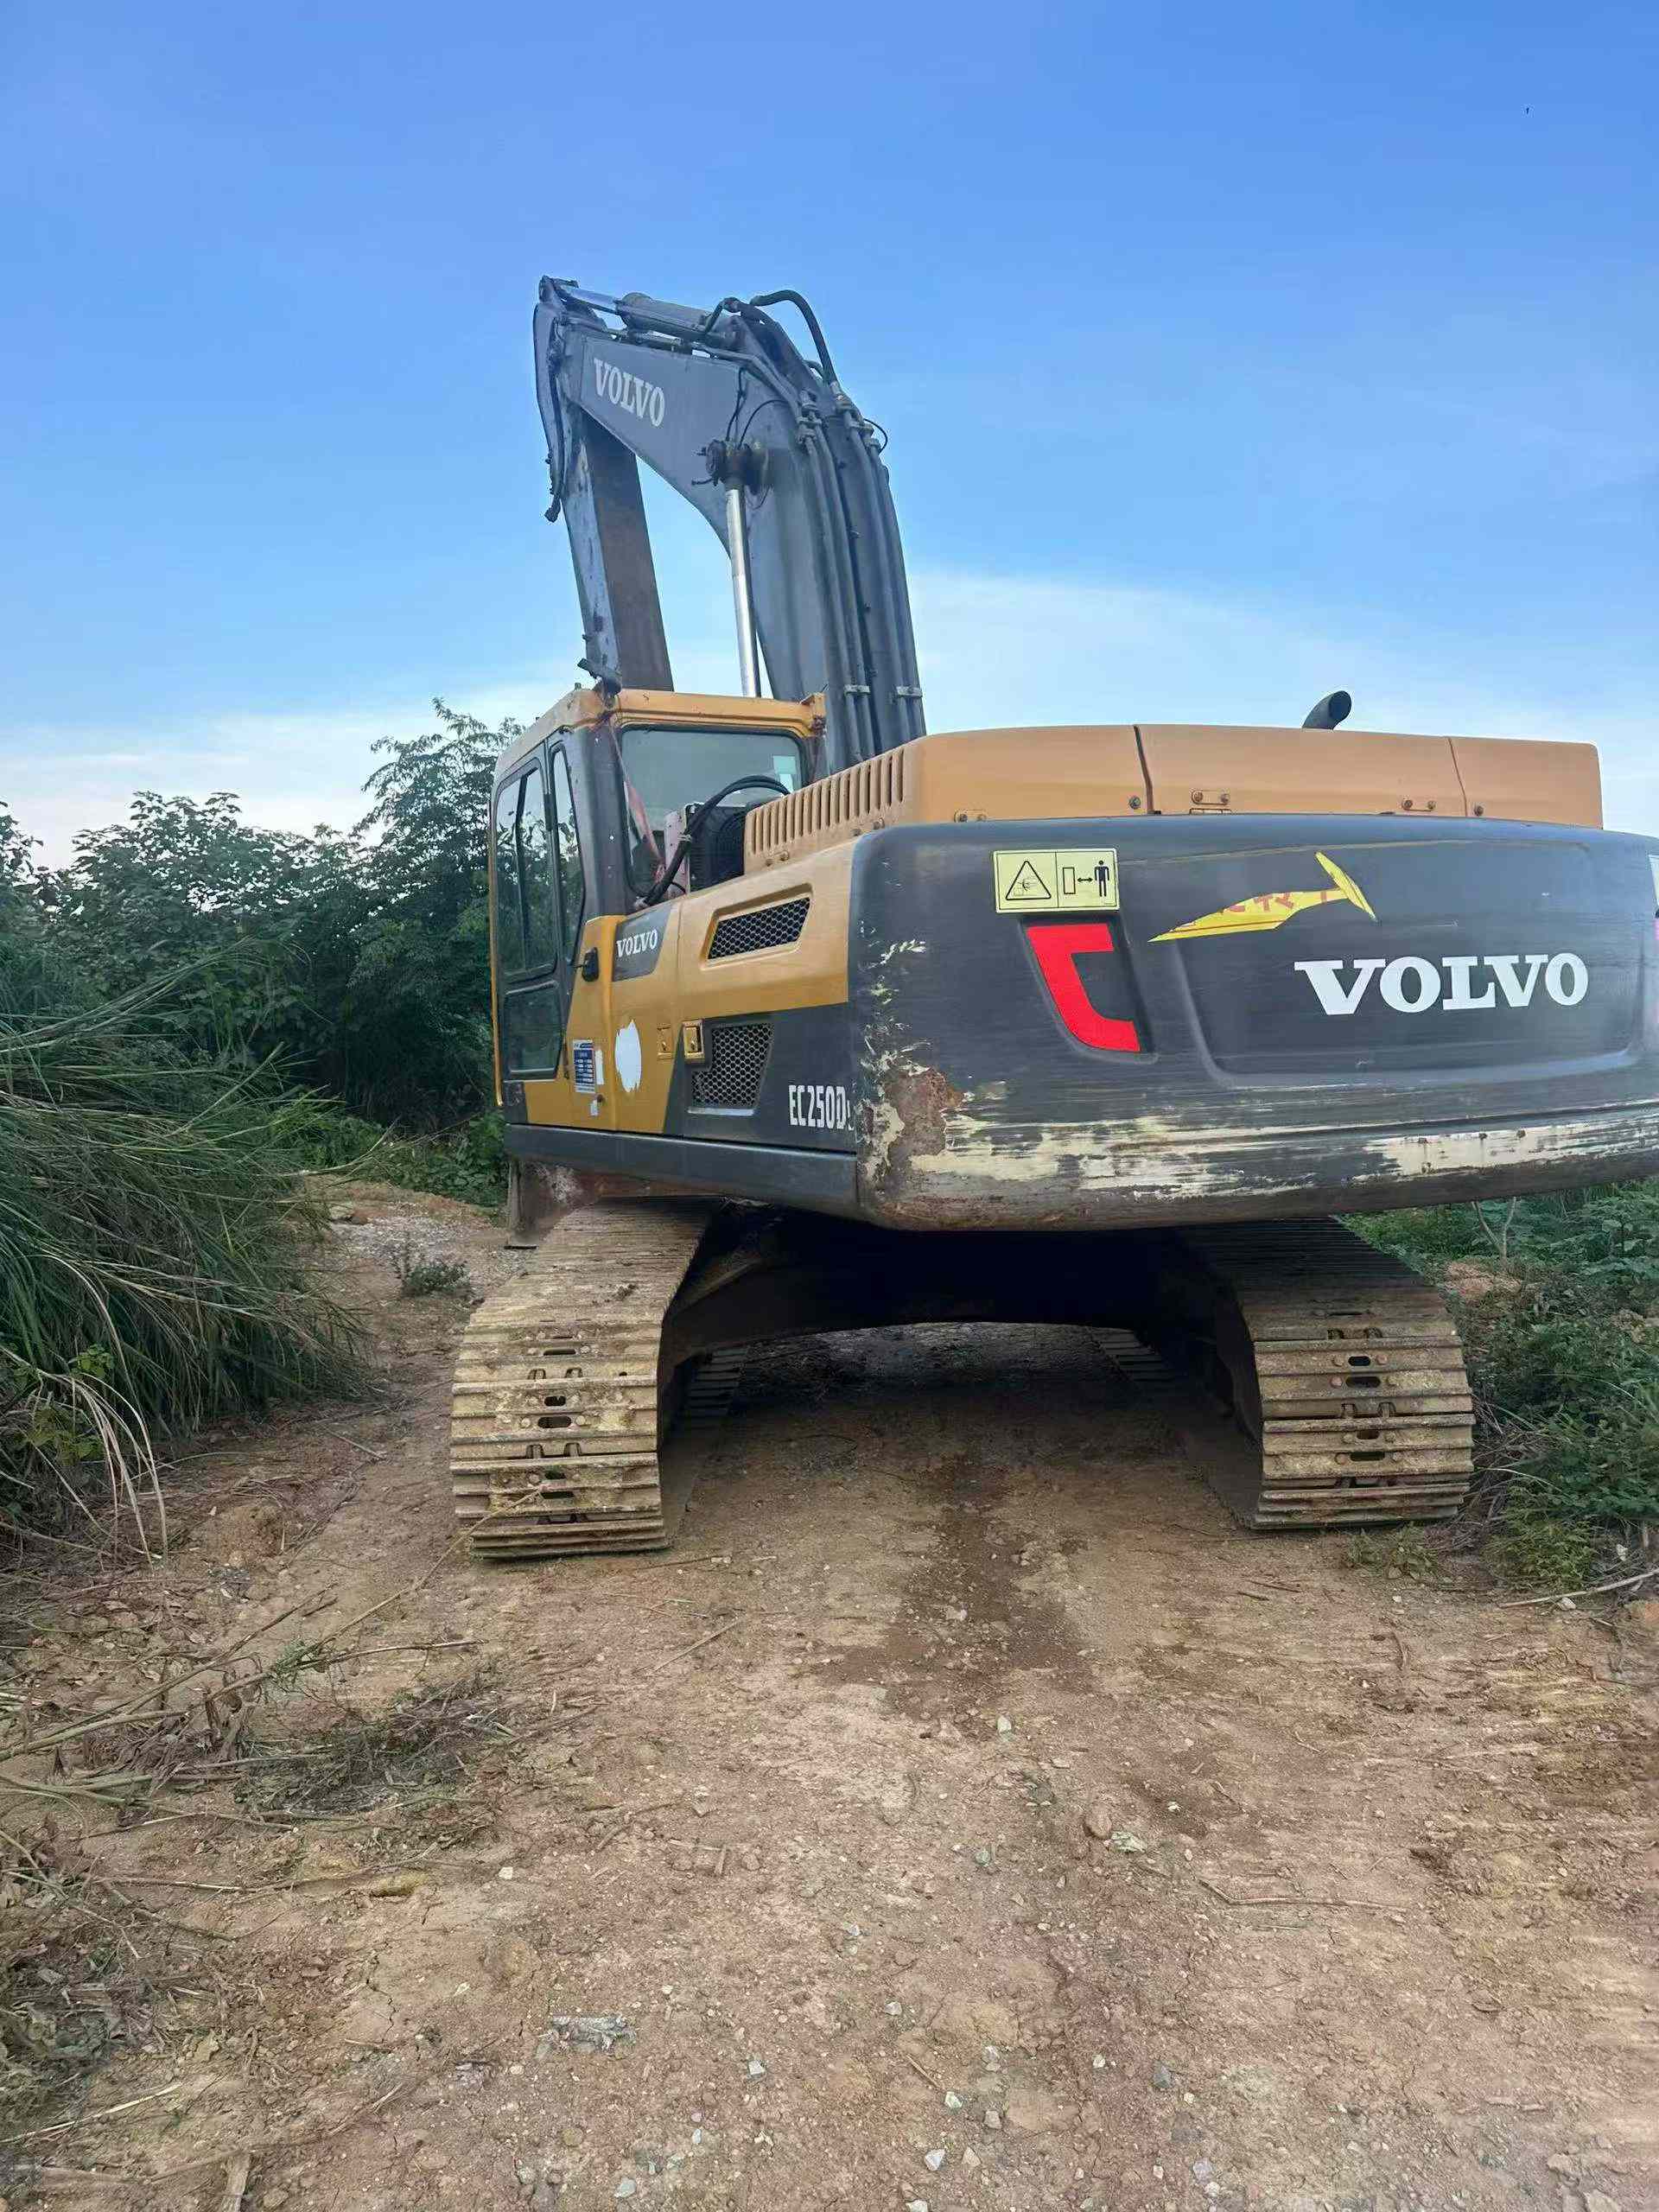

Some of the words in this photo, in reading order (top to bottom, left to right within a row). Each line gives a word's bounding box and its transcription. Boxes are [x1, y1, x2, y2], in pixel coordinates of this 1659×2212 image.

[594, 358, 664, 427] VOLVO
[616, 929, 658, 958] VOLVO
[1294, 952, 1589, 1015] VOLVO
